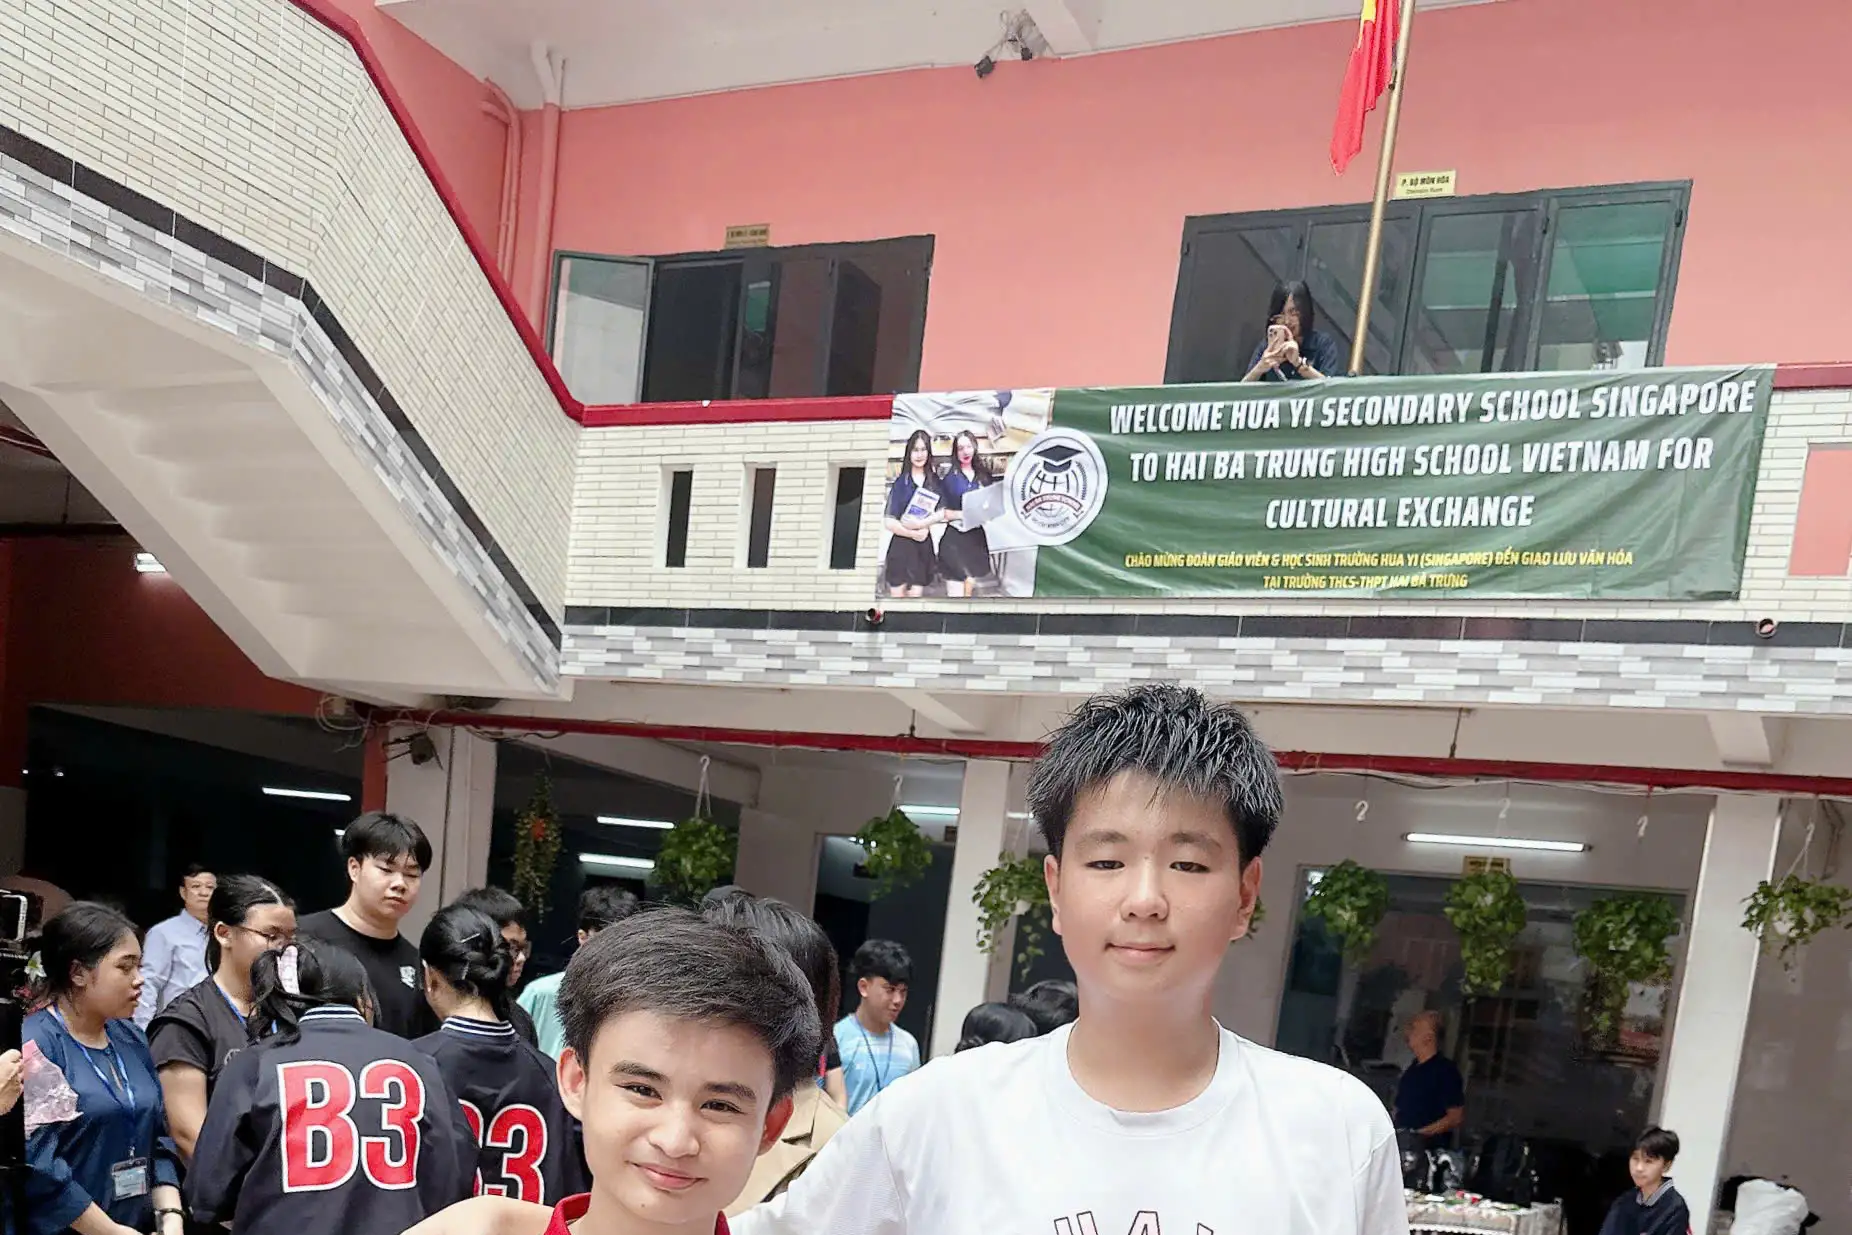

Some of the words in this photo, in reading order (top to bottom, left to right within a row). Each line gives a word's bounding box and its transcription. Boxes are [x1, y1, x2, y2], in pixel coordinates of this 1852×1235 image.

[1110, 402, 1225, 434] WELCOME
[1230, 400, 1281, 430] HUA
[1290, 398, 1314, 428] YI
[1320, 391, 1474, 428] SECONDARY
[1479, 388, 1583, 424] SCHOOL
[1590, 379, 1757, 419] SINGAPORE
[1130, 452, 1159, 482] TO
[1165, 451, 1208, 481] HAI
[1213, 450, 1245, 480] BA
[1254, 448, 1336, 479] TRUNG
[1342, 446, 1408, 478] HIGH
[1413, 443, 1512, 476] SCHOOL
[1521, 439, 1651, 473] VIETNAM
[1657, 436, 1715, 470] FOR
[1265, 497, 1389, 529] CULTURAL
[1396, 494, 1536, 528] EXCHANGE
[1217, 551, 1243, 567] GIÁO
[1244, 551, 1269, 567] VIÊN
[1271, 553, 1280, 567] &
[1282, 553, 1303, 569] HỌC
[1304, 553, 1332, 567] SINH
[1334, 551, 1380, 567] TRƯỜNG
[1380, 553, 1405, 567] HUA
[1407, 553, 1418, 566] YI
[1420, 551, 1493, 568] (SINGAPORE)
[1495, 546, 1519, 565] ĐẾN
[1521, 551, 1551, 565] GIAO
[1579, 549, 1605, 565] VĂN
[1607, 548, 1633, 565] HÓA
[1283, 573, 1327, 589] TRƯỜNG
[1329, 575, 1389, 589] THCS-THPT
[277, 1058, 426, 1194] B3
